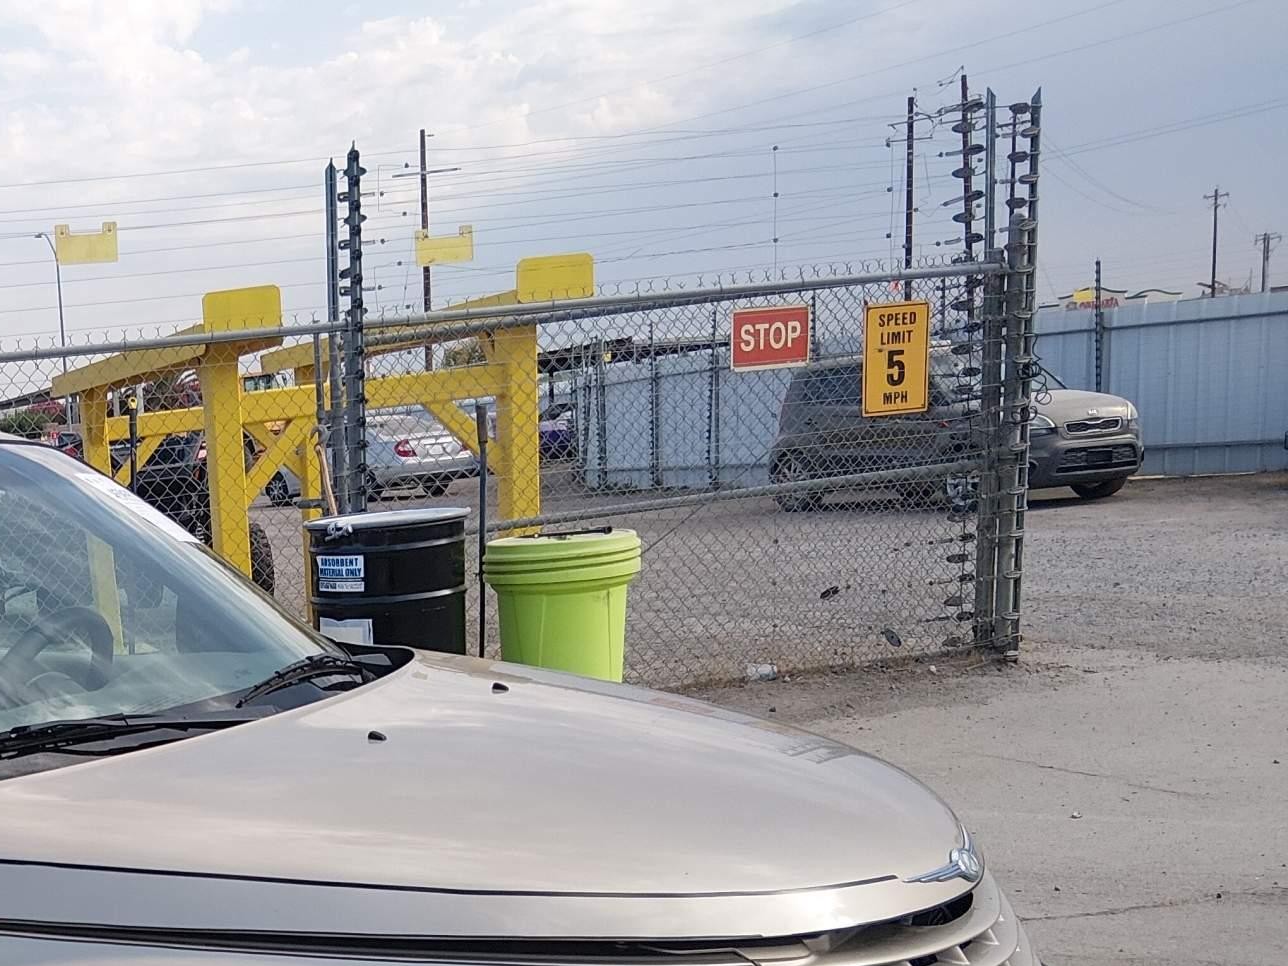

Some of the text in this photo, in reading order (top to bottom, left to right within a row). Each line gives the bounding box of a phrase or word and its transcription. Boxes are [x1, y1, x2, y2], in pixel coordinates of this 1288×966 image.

[878, 311, 917, 328] SPEED
[740, 320, 801, 352] STOP
[880, 330, 914, 345] LIMIT
[886, 349, 905, 387] 5
[882, 391, 909, 405] MPH
[320, 557, 359, 568] ABSORBENT
[345, 567, 362, 577] ONLY
